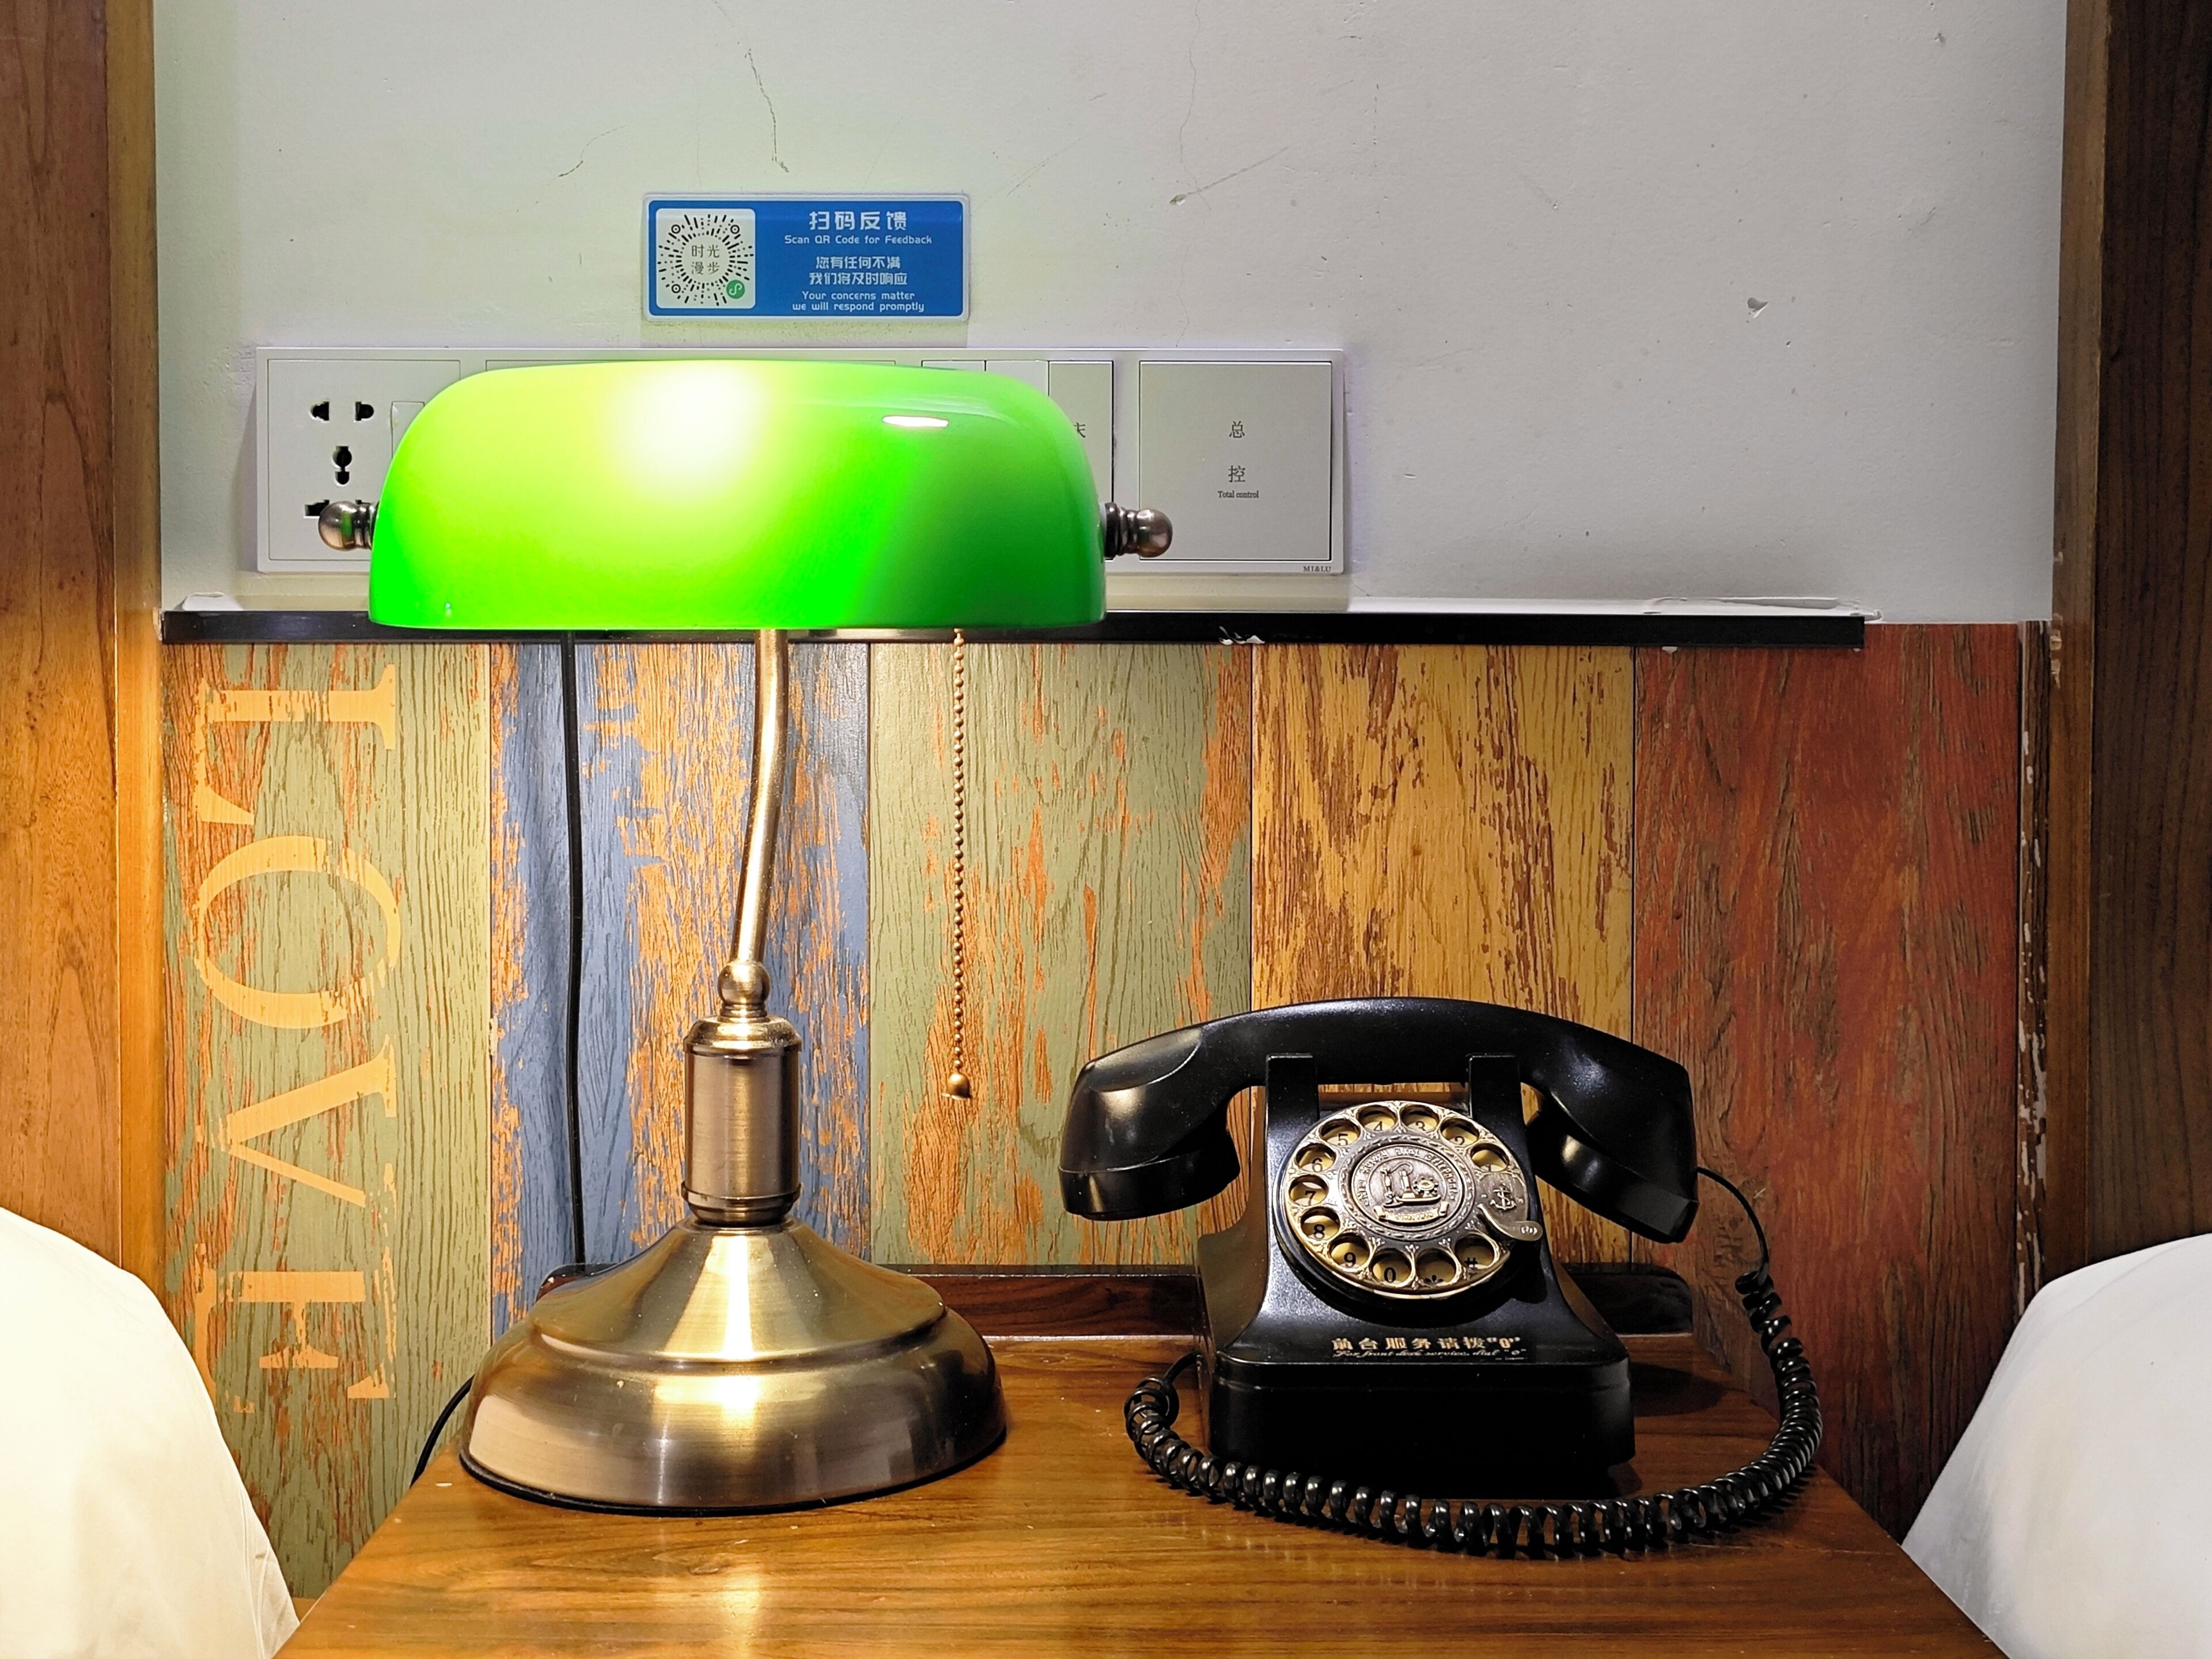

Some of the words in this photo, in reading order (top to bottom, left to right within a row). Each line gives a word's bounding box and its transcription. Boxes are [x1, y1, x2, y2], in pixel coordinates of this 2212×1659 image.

[809, 211, 907, 230] 扫码反馈
[784, 235, 809, 244] Scan
[815, 235, 830, 244] QR
[835, 235, 859, 244] Code
[865, 235, 880, 244] for
[885, 235, 932, 244] Feedback
[691, 244, 720, 258] 时光
[691, 262, 720, 275] 漫步
[816, 256, 900, 269] 您有任何不满
[809, 272, 907, 285] 我们将及时响应
[802, 291, 826, 300] Your
[881, 291, 915, 300] matter
[812, 302, 828, 310] will
[834, 302, 874, 312] respond
[880, 302, 924, 312] promptly
[1217, 490, 1234, 498] Total
[1236, 490, 1259, 498] control
[193, 664, 399, 1413] LOVE
[1373, 1121, 1382, 1131] 4
[1338, 1133, 1348, 1146] 5
[1312, 1158, 1323, 1172] 6
[1305, 1190, 1316, 1206] 7
[1314, 1224, 1325, 1239] 8
[1343, 1252, 1356, 1267] 9
[1384, 1267, 1396, 1283] 0
